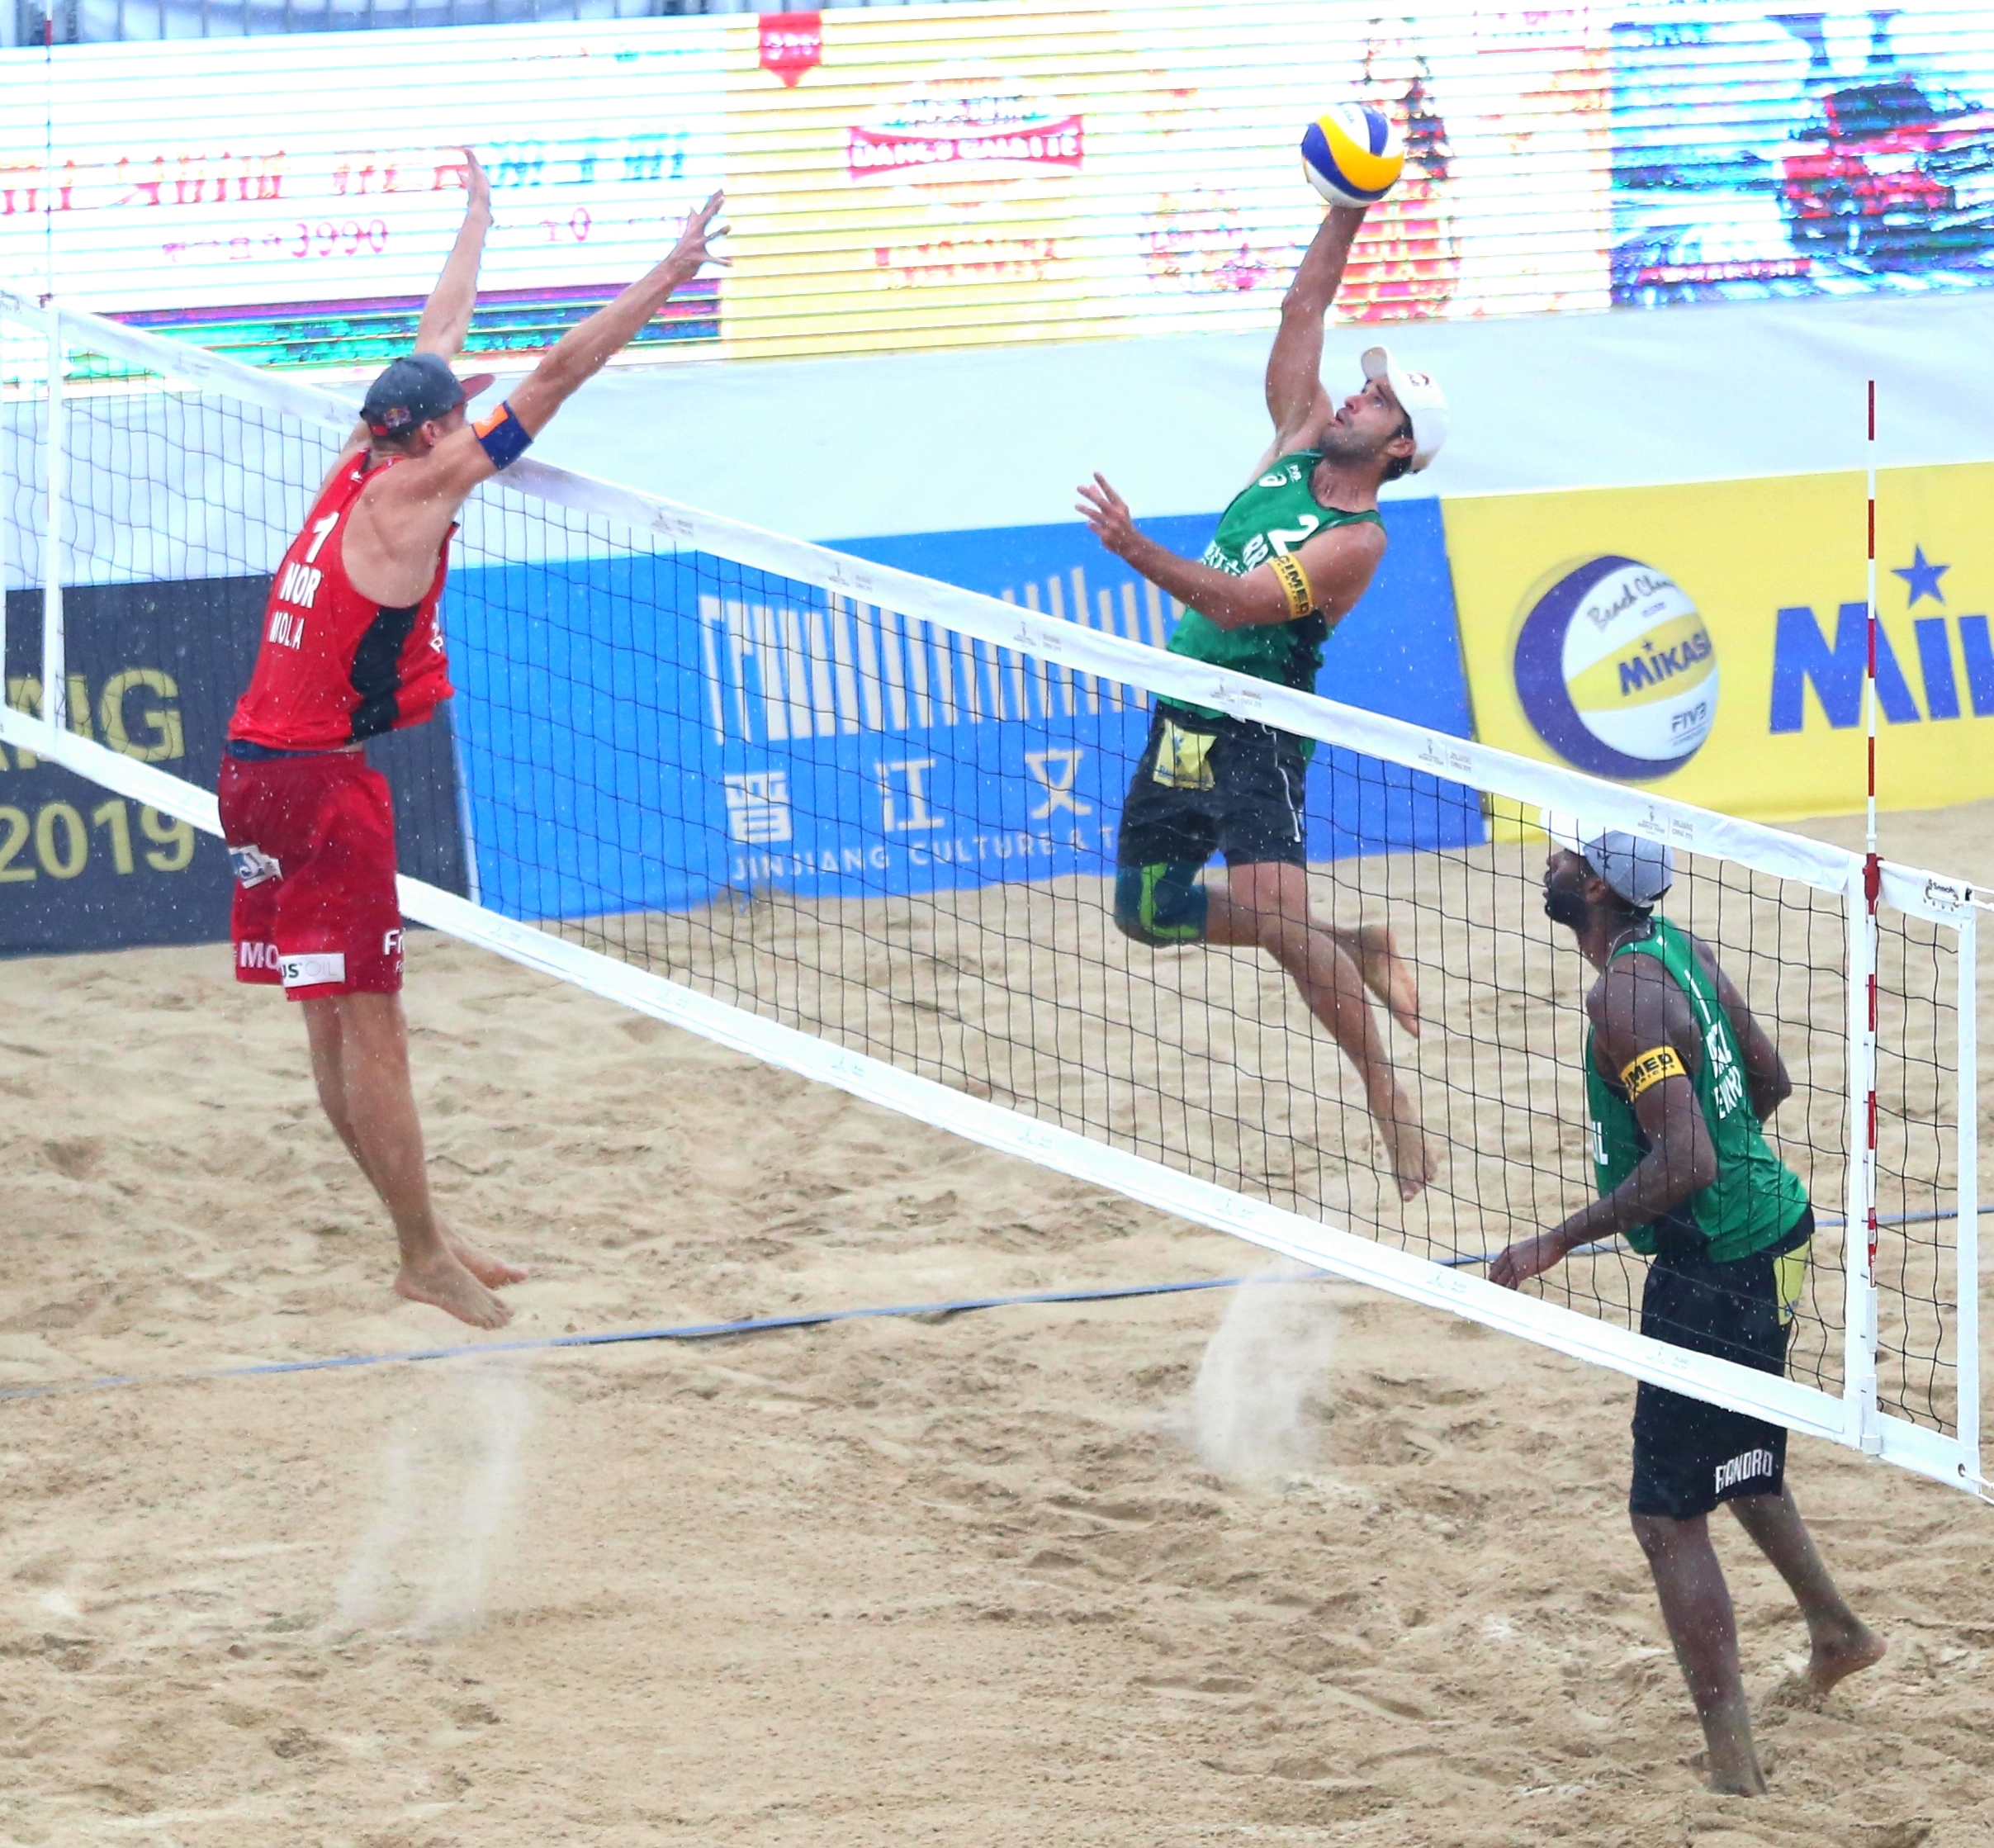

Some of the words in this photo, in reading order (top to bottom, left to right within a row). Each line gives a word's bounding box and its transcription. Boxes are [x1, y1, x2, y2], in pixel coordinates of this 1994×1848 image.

[305, 512, 339, 563] 1
[1267, 514, 1319, 557] 2
[279, 562, 322, 609] NOR
[0, 798, 196, 883] 2019
[732, 845, 889, 881] JINJIANG
[909, 830, 1054, 866] CULTURE
[306, 960, 337, 977] OIL
